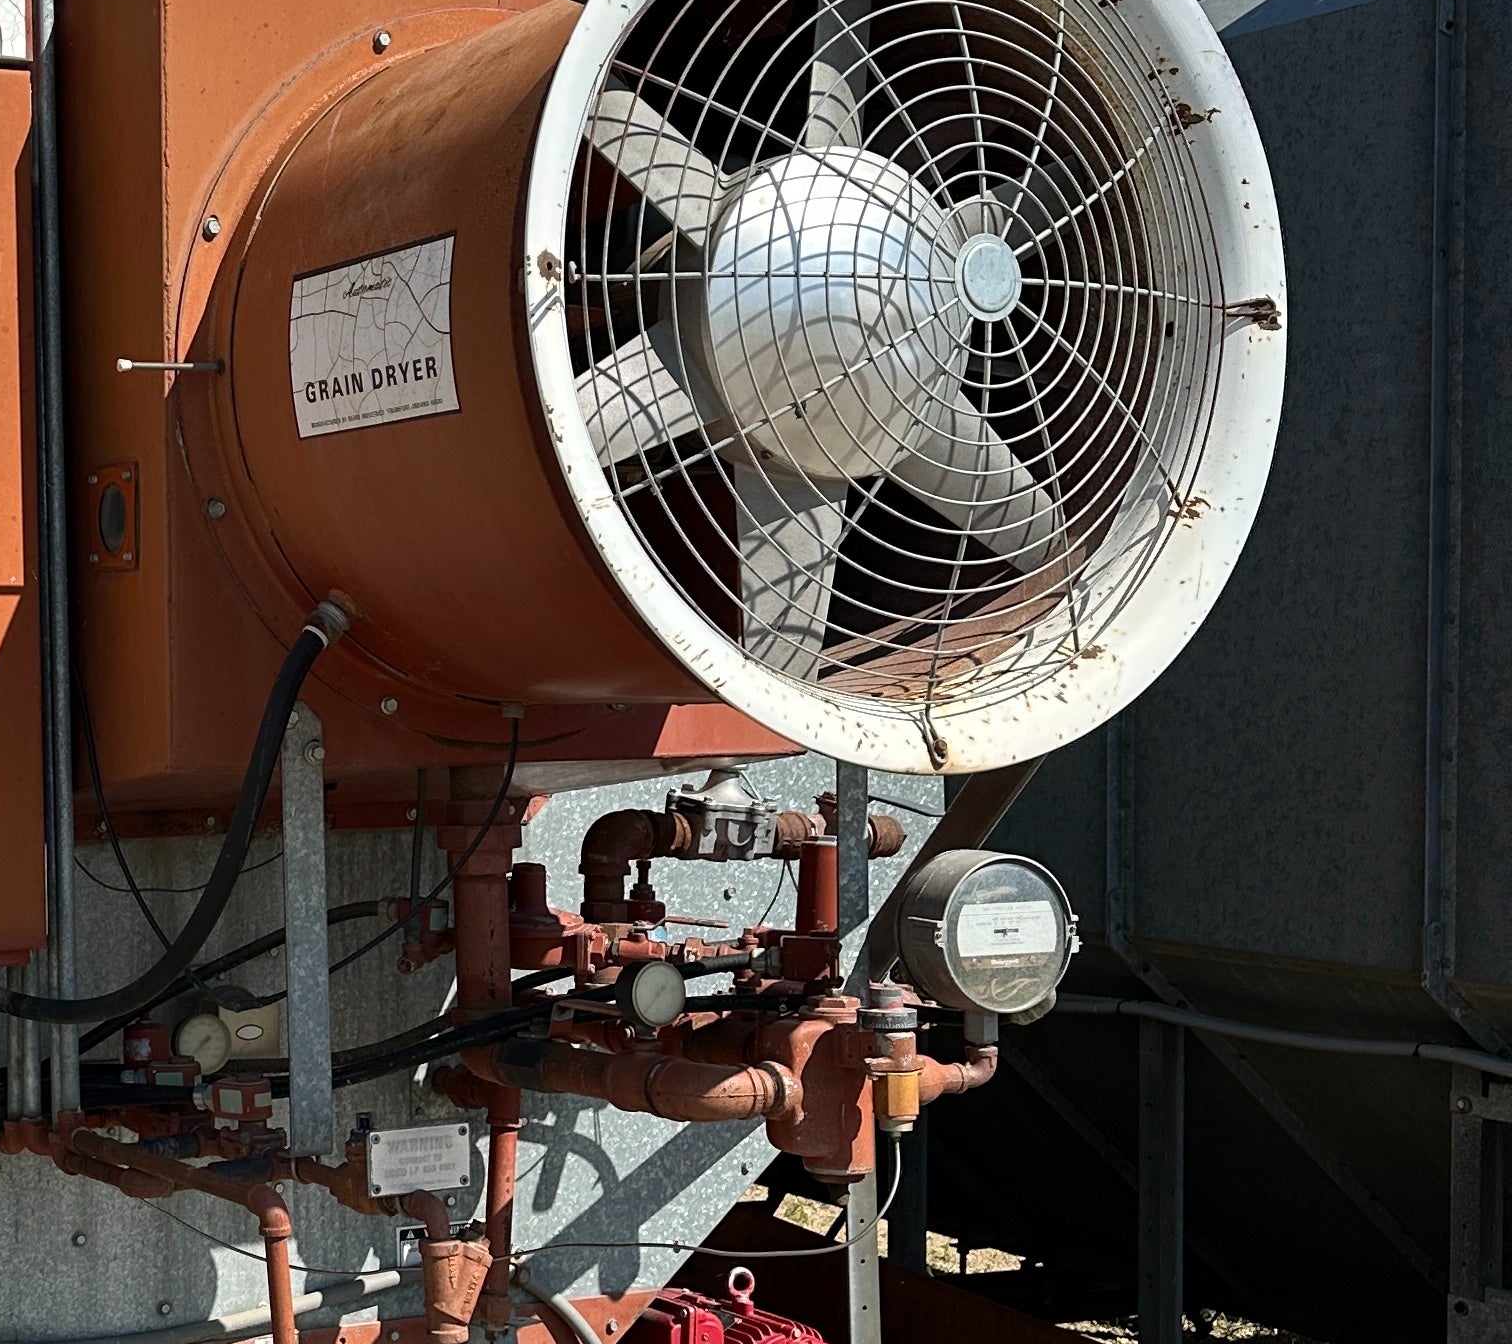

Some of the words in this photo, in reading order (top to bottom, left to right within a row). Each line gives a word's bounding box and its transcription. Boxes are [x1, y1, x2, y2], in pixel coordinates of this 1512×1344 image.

[305, 371, 364, 403] GRAIN
[371, 356, 438, 390] DRYER
[387, 1135, 453, 1153] WARNING
